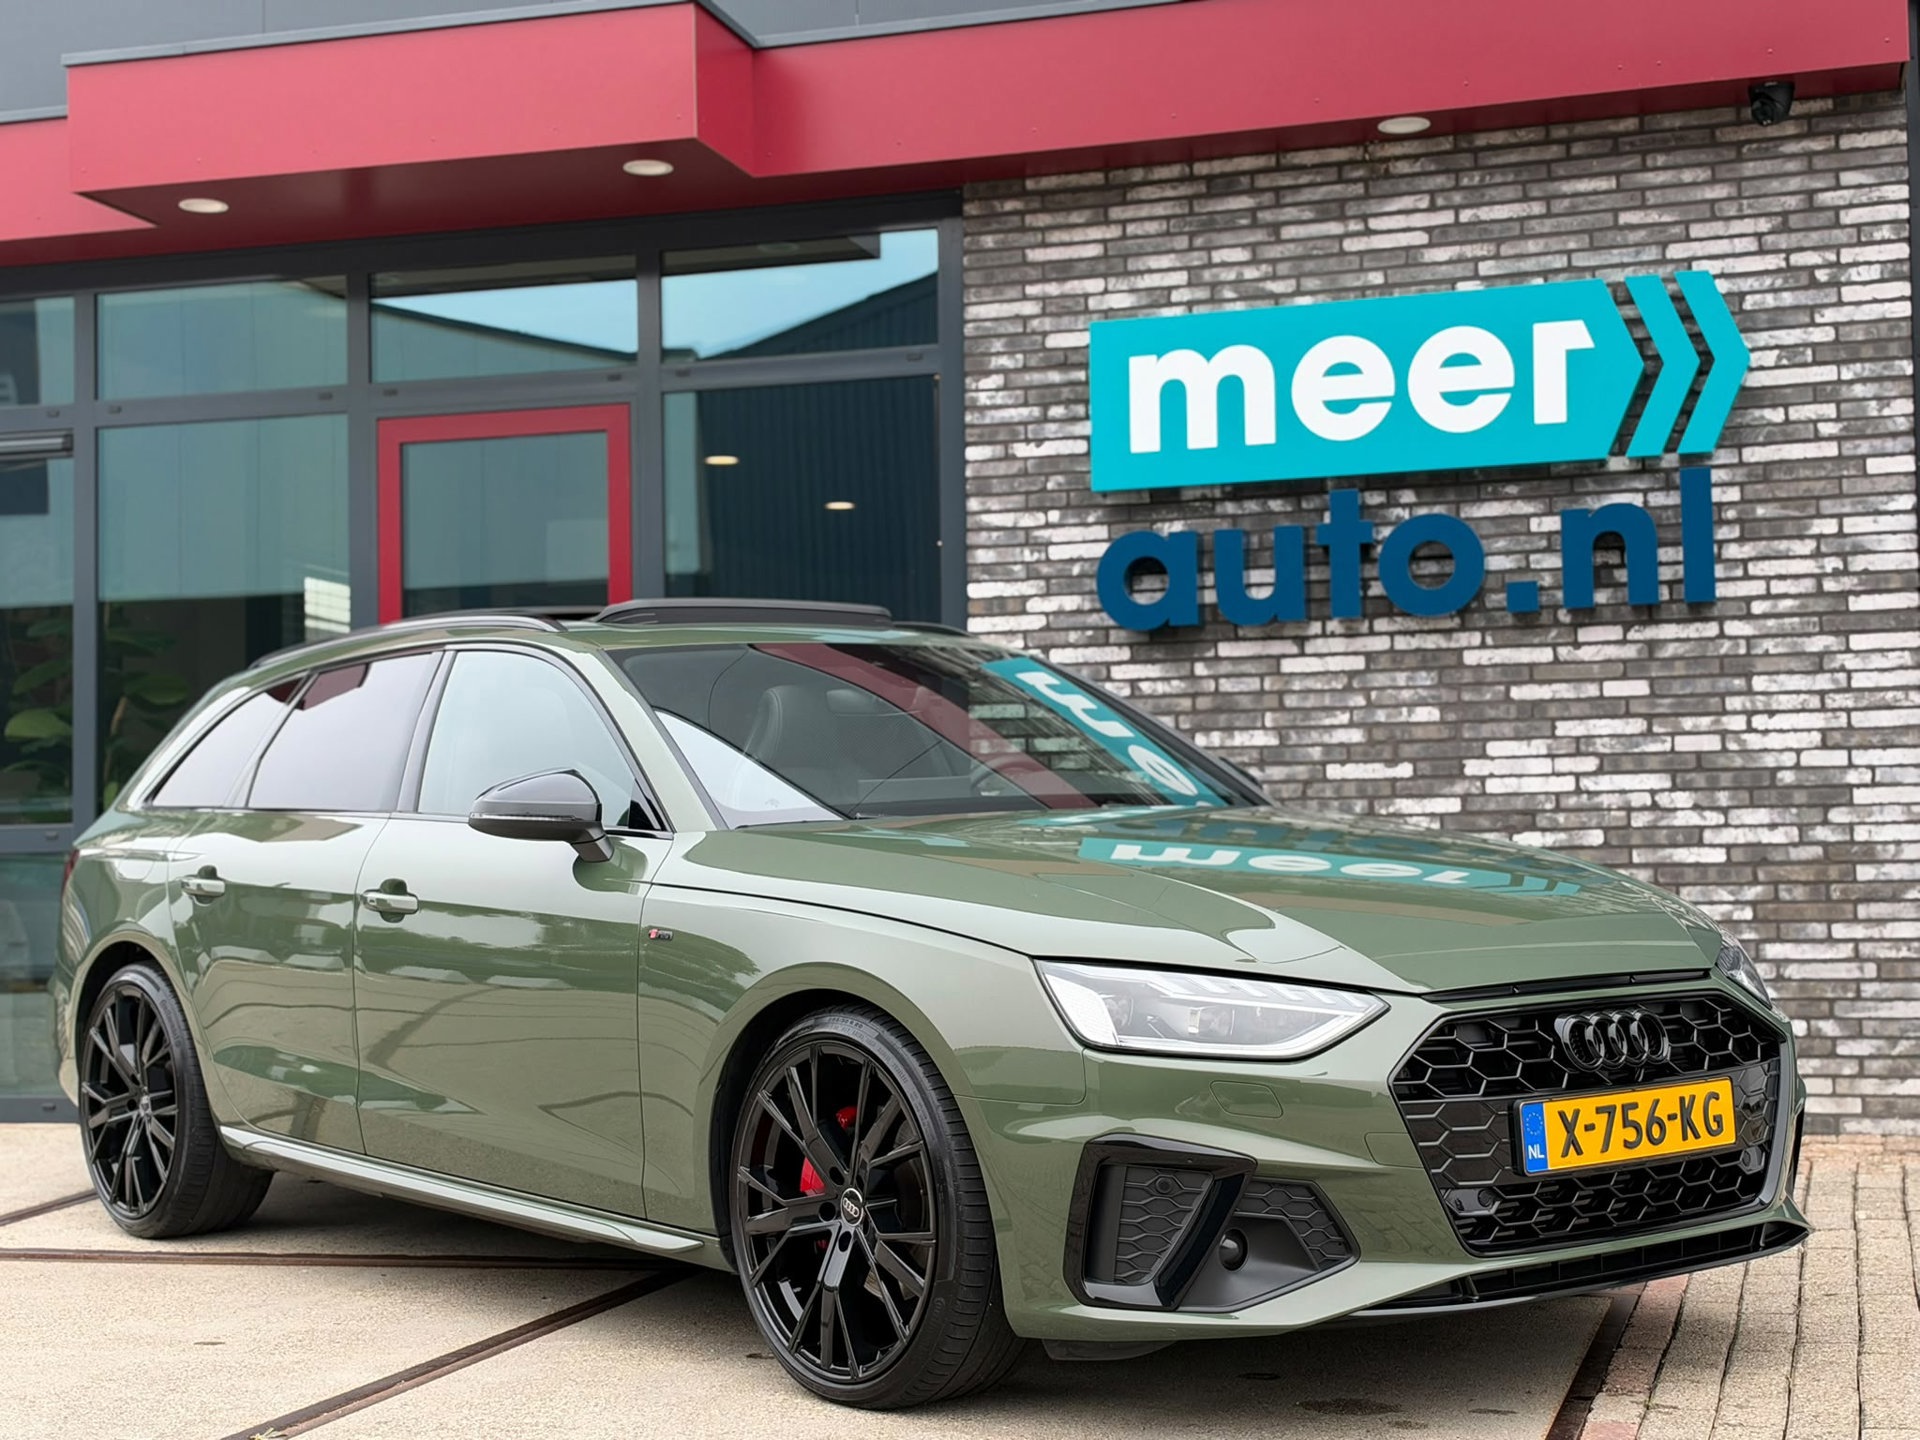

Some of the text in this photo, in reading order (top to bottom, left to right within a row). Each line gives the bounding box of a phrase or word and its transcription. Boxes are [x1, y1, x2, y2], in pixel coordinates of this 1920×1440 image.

[1129, 319, 1594, 453] meer
[1097, 466, 1716, 631] auto.nl
[1527, 1144, 1545, 1159] NL
[1557, 1091, 1724, 1158] X-756-KG
